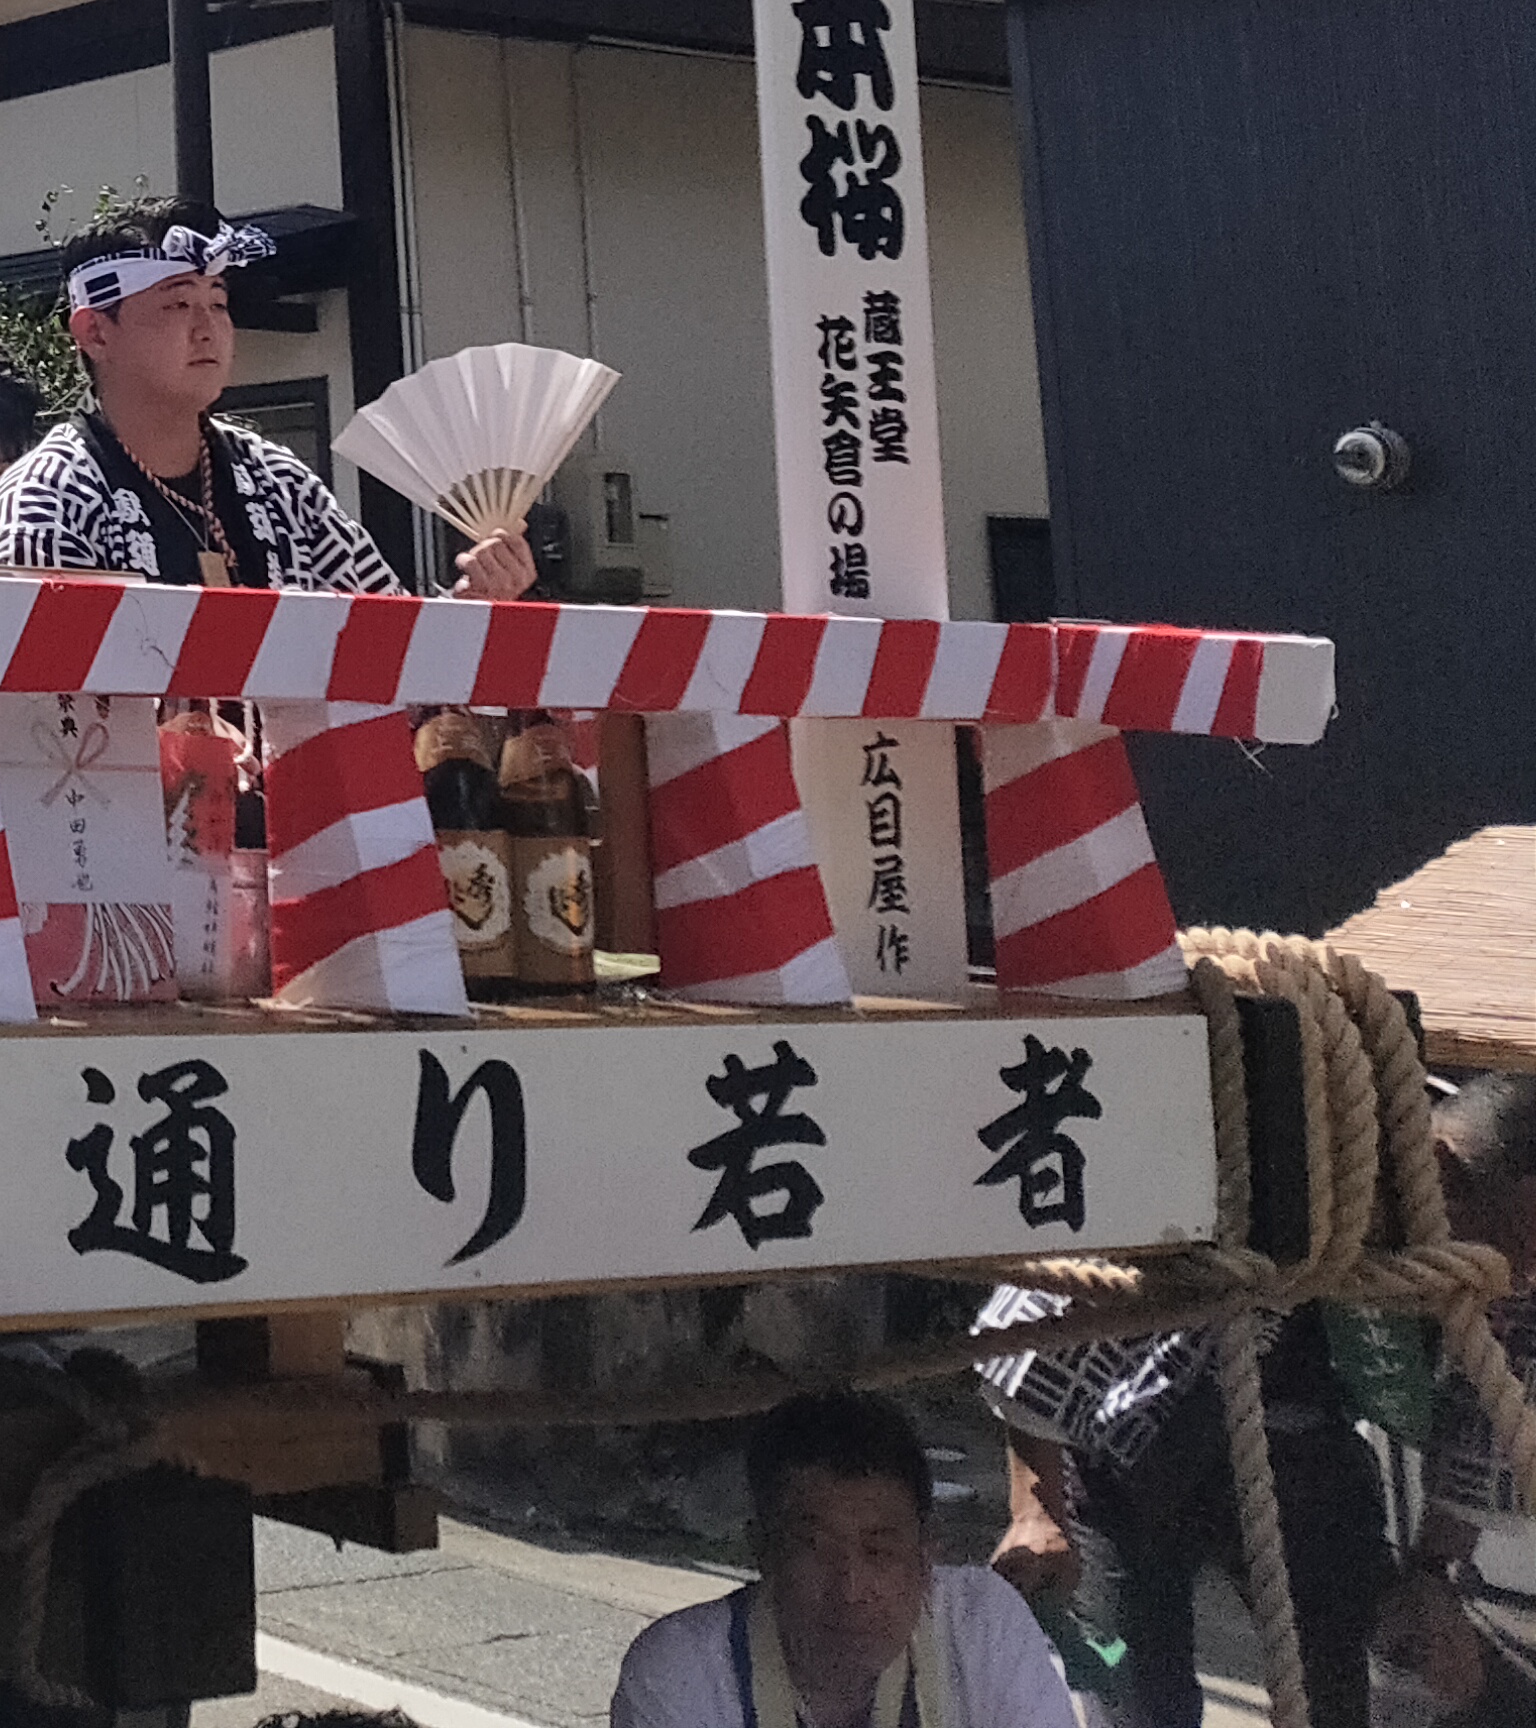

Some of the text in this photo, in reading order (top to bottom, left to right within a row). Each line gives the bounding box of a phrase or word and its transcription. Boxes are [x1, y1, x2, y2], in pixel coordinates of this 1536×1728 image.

[815, 314, 871, 600] 花矢倉の場
[862, 290, 910, 466] 蔵王堂
[859, 731, 912, 976] 広目屋作
